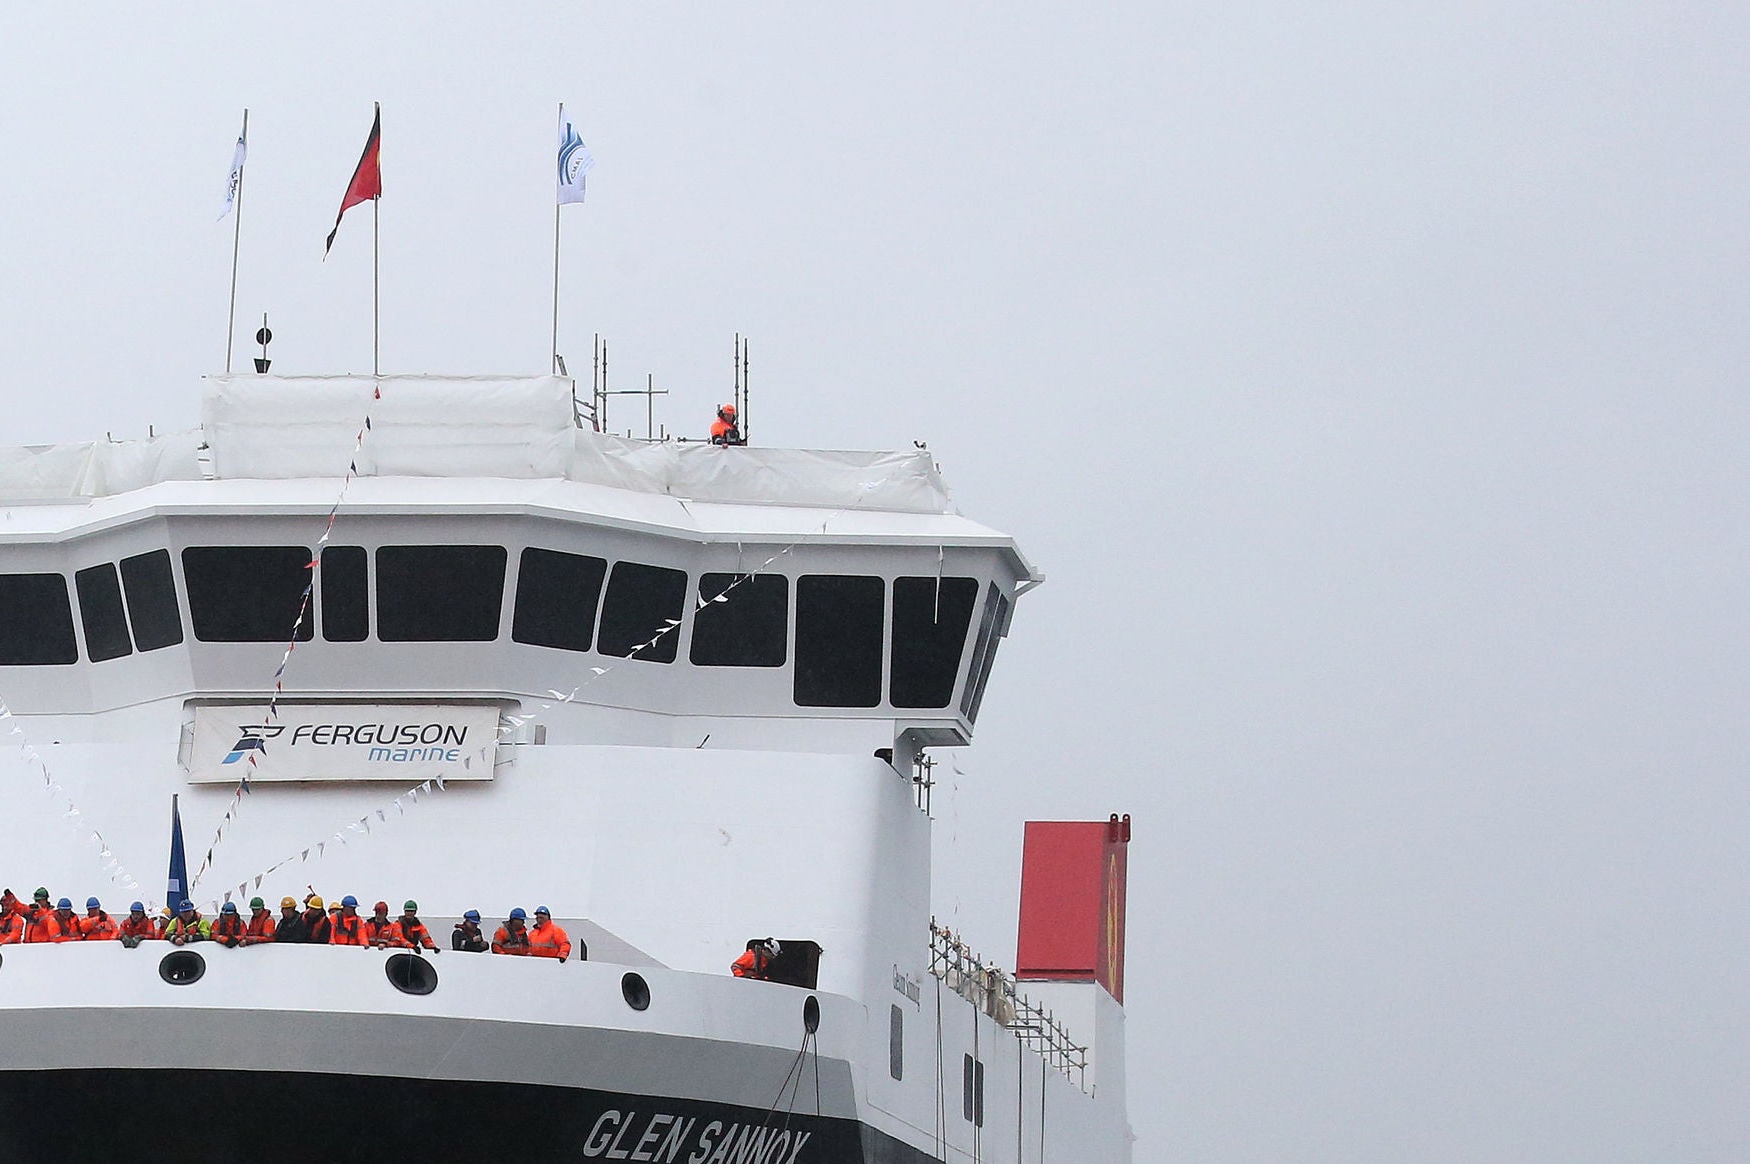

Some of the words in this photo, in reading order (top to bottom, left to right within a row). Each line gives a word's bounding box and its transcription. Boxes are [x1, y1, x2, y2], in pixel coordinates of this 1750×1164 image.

[291, 724, 468, 746] FERGUSON
[368, 747, 460, 762] marine
[583, 1110, 696, 1164] GLEN
